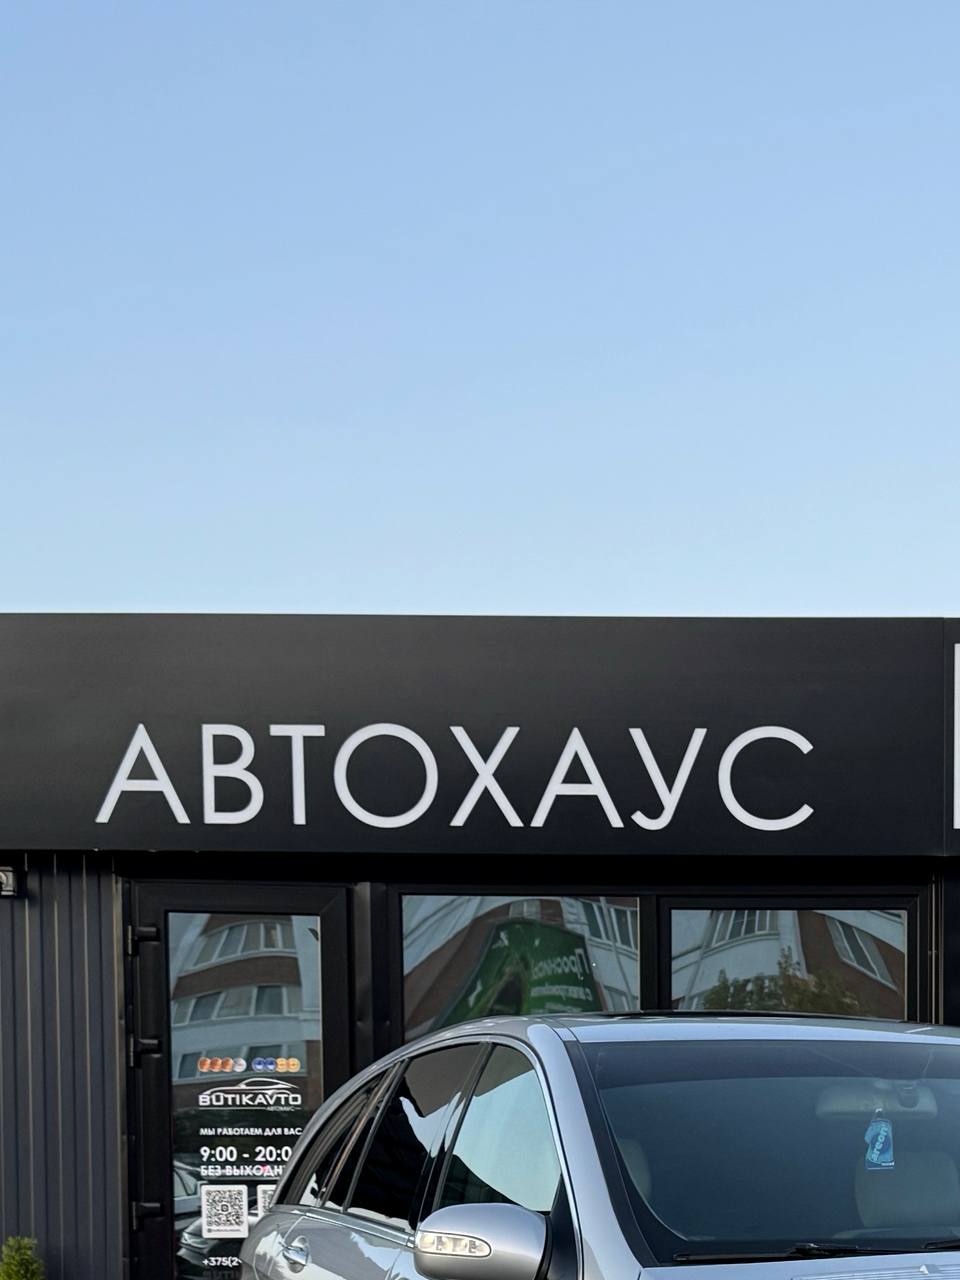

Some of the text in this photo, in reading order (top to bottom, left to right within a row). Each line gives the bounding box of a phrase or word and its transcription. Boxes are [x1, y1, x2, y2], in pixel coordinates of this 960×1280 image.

[96, 723, 813, 830] АВТОХАУС
[198, 1094, 301, 1106] BUTIKAVTO
[201, 1147, 237, 1161] 9:00
[255, 1146, 292, 1162] 20:0
[200, 1165, 285, 1177] БЕЗ ВЫХОДН
[202, 1256, 242, 1267] +375(2
